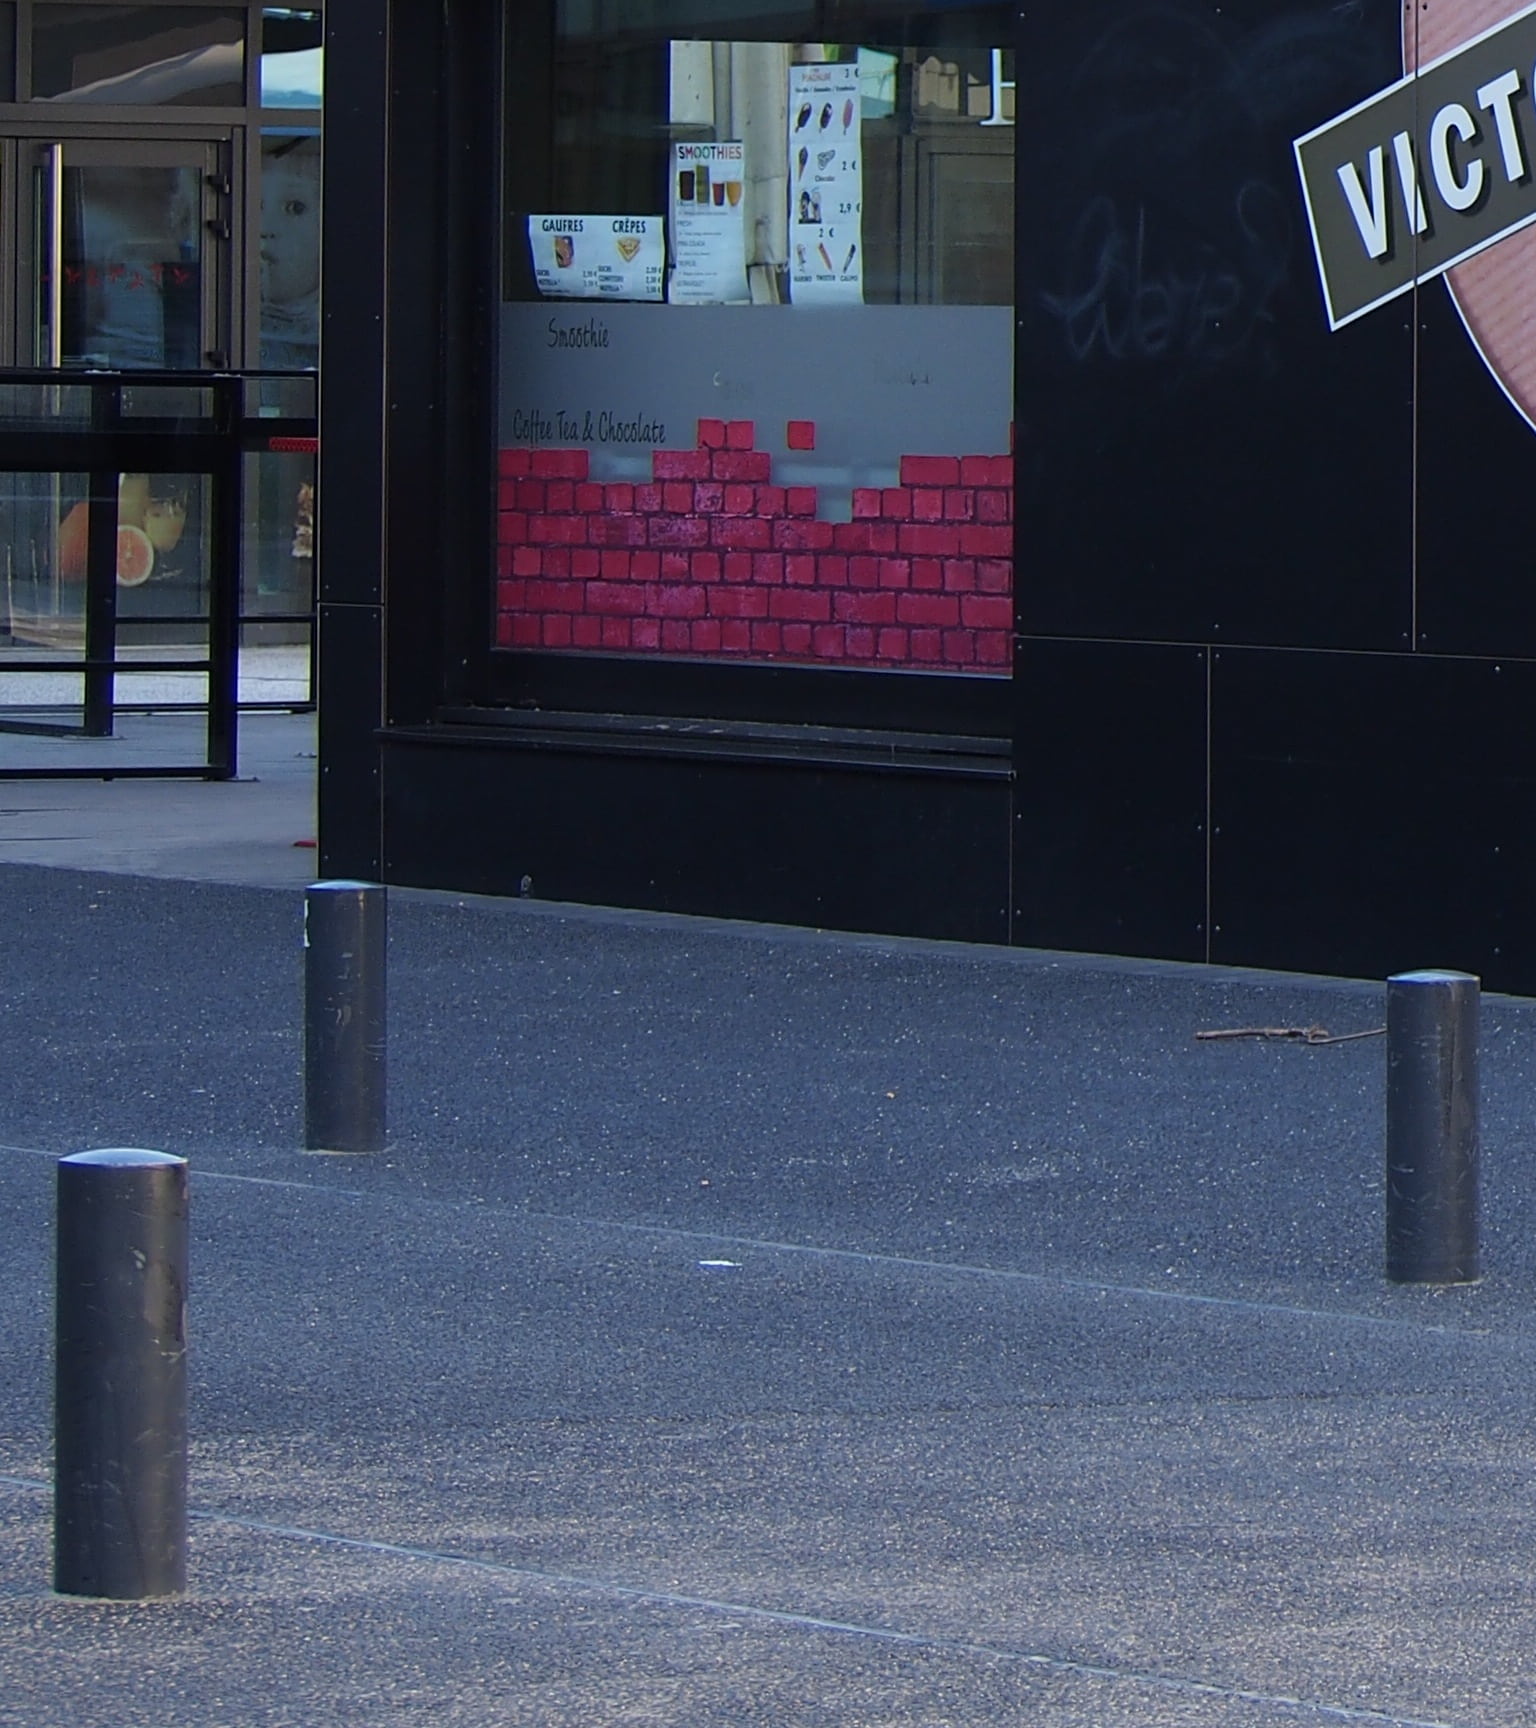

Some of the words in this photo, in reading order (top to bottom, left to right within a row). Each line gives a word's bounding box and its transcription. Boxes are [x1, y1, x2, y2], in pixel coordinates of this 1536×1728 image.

[678, 145, 742, 160] SMOOTHIES
[542, 218, 584, 233] GAUFRES
[612, 217, 647, 234] CRÊPES
[547, 317, 610, 349] Smoothie
[512, 408, 553, 445] Coffee
[556, 409, 579, 441] Tea
[582, 409, 594, 442] &
[598, 410, 667, 444] Chocolate
